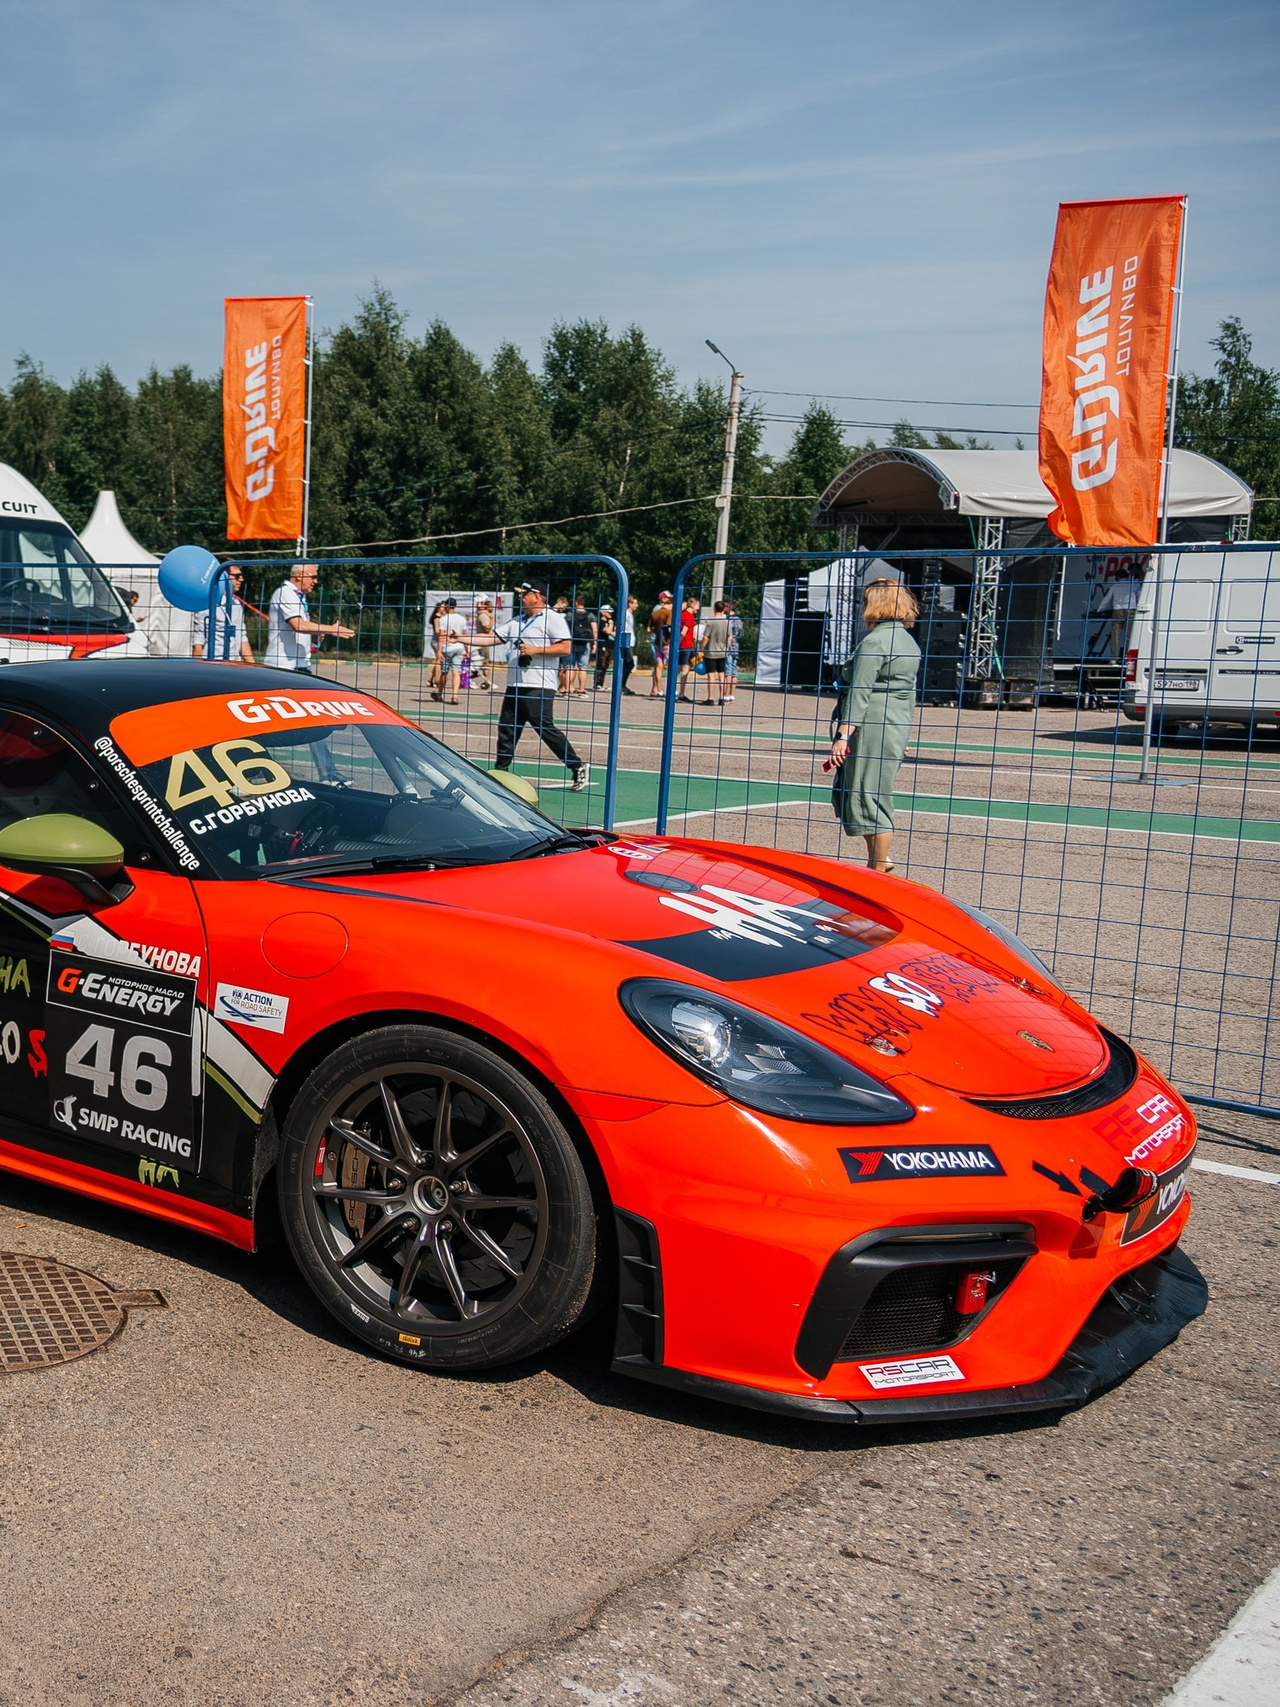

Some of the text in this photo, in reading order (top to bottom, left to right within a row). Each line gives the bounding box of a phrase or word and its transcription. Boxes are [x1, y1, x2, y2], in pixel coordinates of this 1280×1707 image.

[165, 739, 291, 811] 46
[94, 736, 200, 871] @porschesprintchallenge
[659, 884, 850, 948] HA
[240, 1000, 258, 1012] ROAD
[258, 1004, 283, 1017] SAFETY
[243, 992, 273, 1006] ACTION
[65, 1023, 173, 1112] 46
[78, 1107, 192, 1158] SMP RACING
[1123, 1112, 1187, 1167] MOTORSPORT
[884, 1150, 995, 1172] YOKOHAMA
[866, 1359, 952, 1378] RSCAR
[874, 1370, 956, 1385] MOTORSPORT
